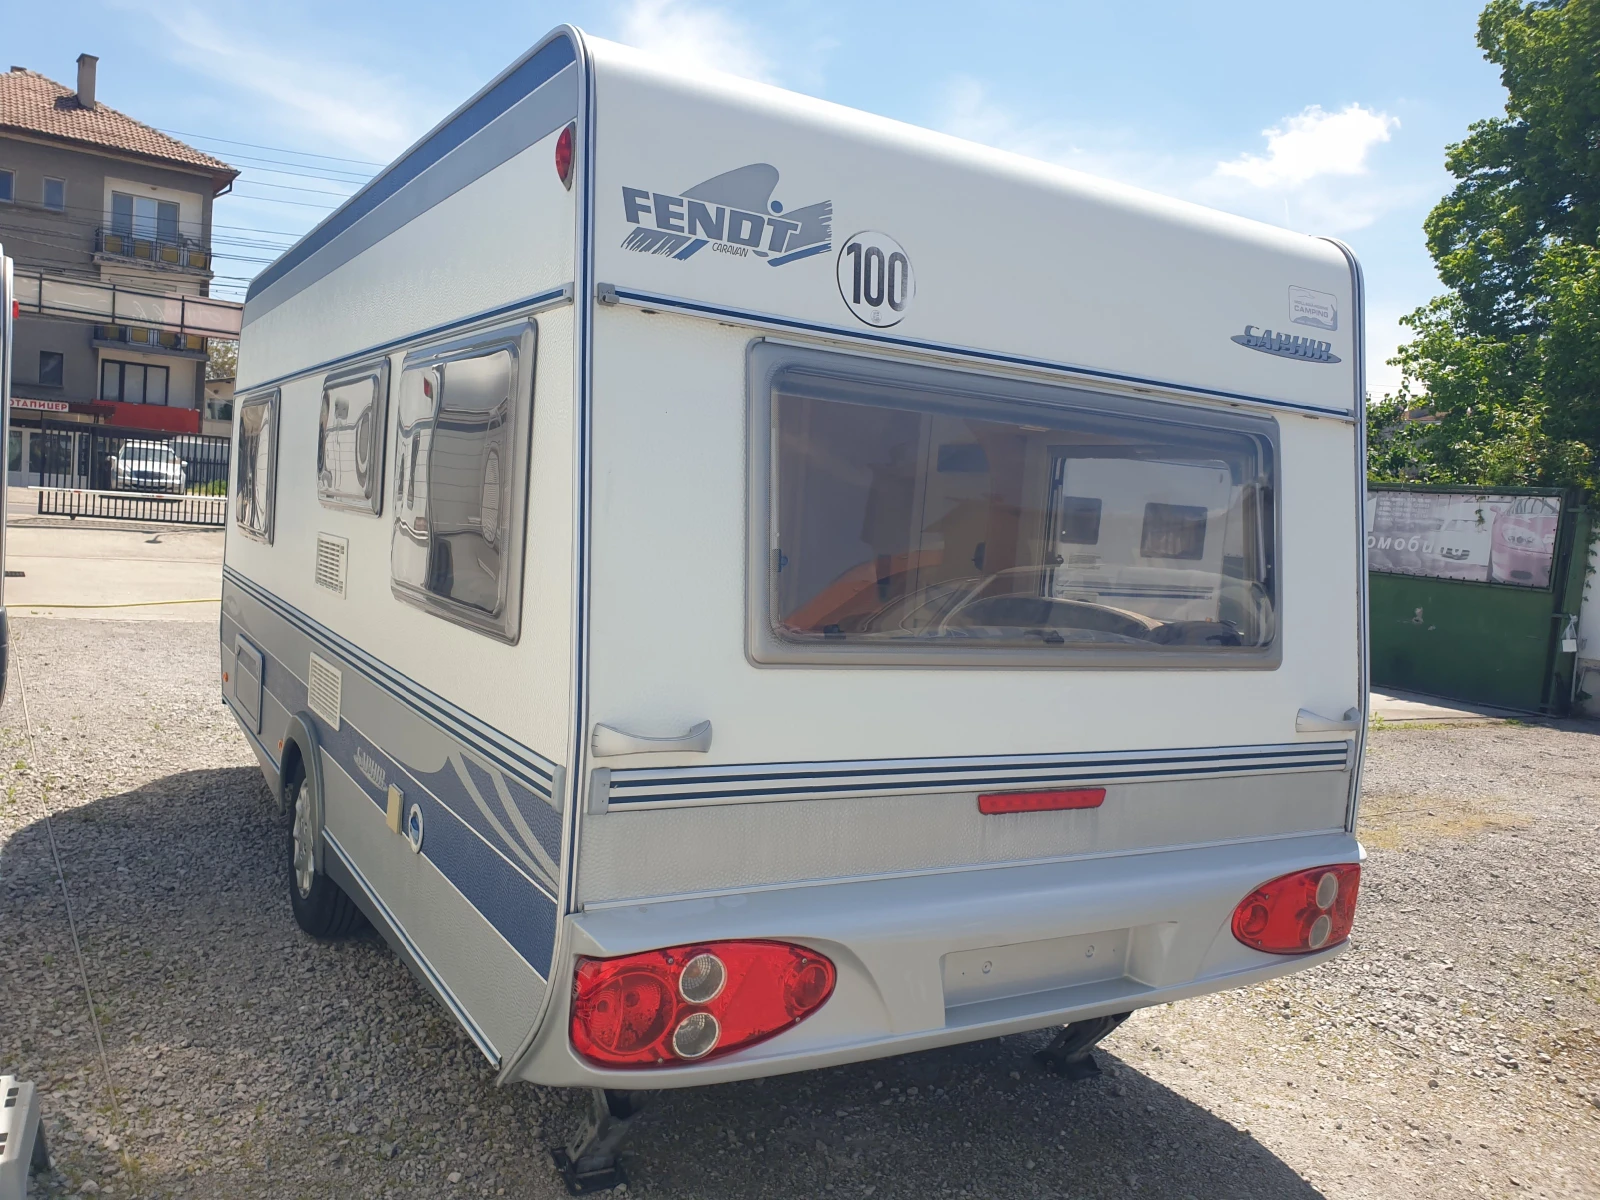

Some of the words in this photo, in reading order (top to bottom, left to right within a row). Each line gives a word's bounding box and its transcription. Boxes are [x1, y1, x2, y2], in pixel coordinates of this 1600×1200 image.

[622, 186, 799, 253] FENDT
[712, 242, 748, 258] CARAVAN
[847, 242, 909, 312] 100
[1294, 305, 1328, 318] CAMPING
